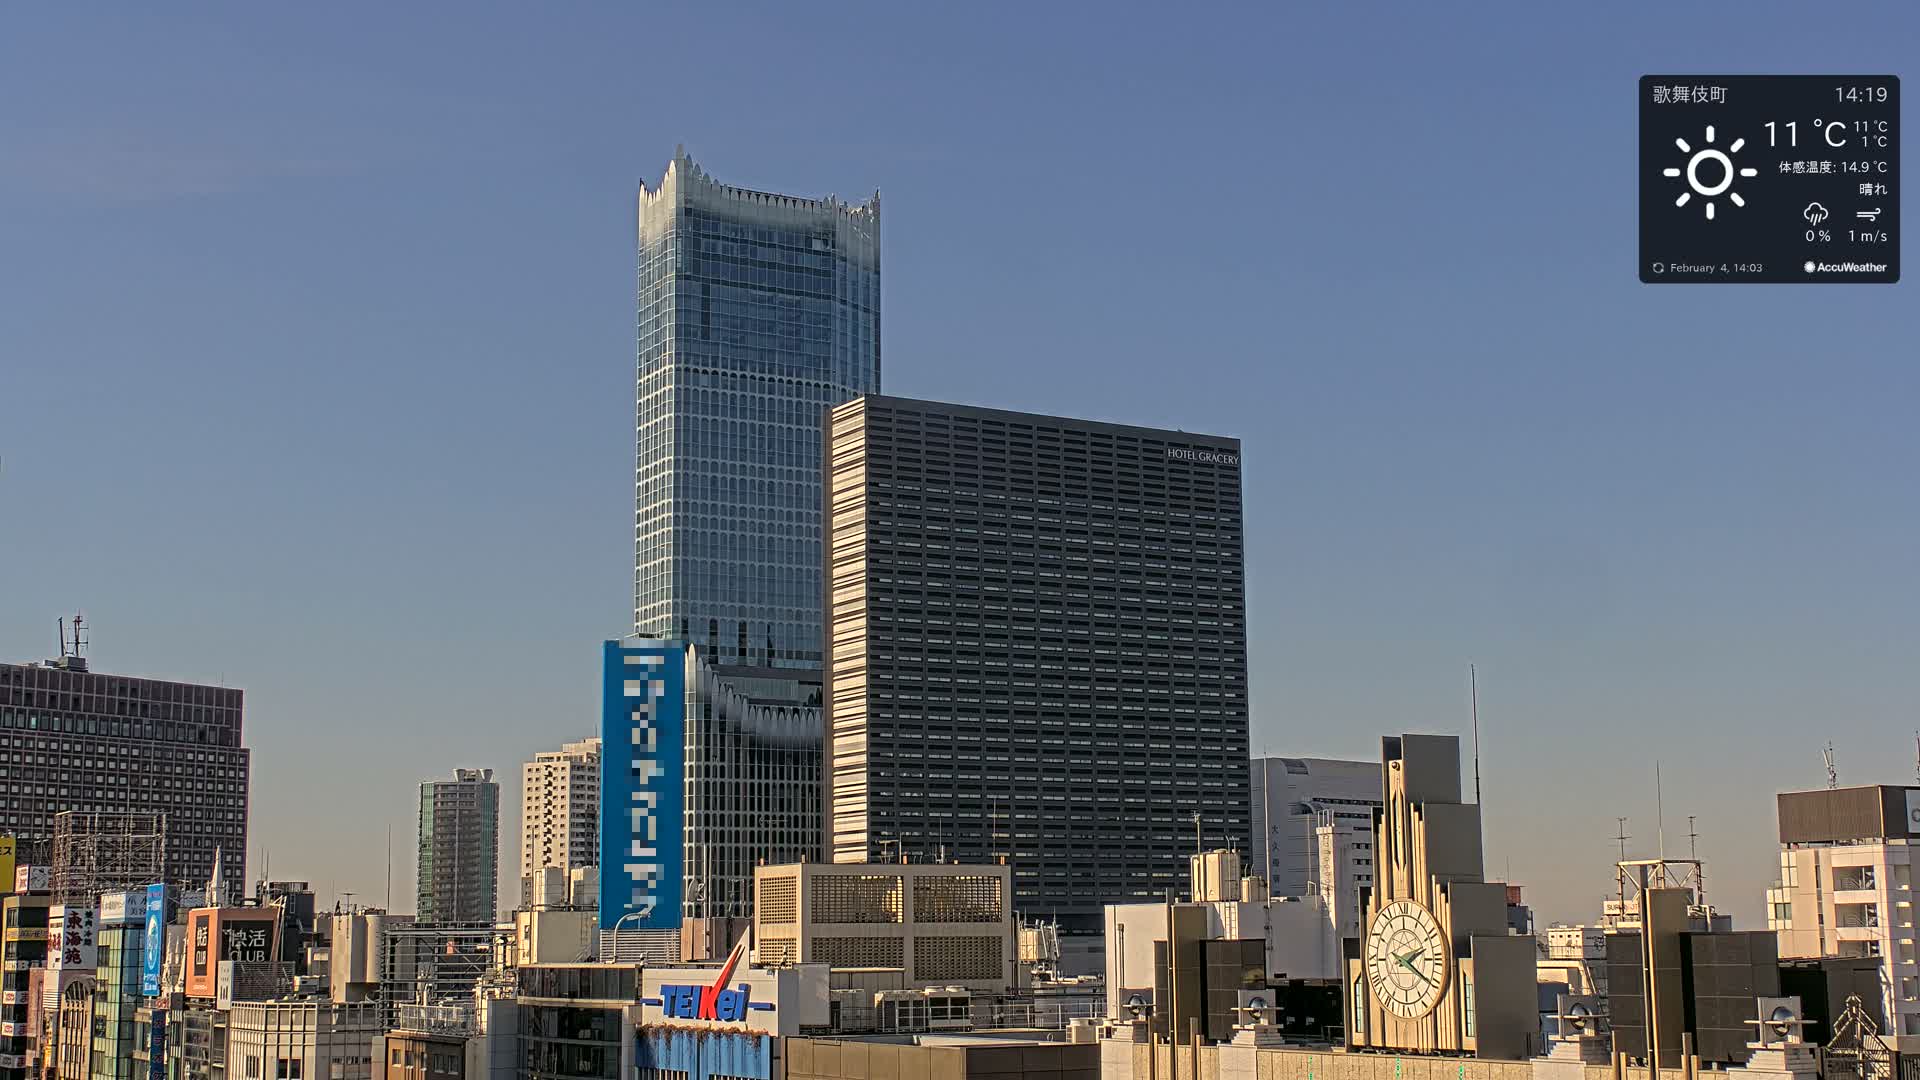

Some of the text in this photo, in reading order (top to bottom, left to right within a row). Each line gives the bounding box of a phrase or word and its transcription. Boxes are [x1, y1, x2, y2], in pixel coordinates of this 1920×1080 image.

[1167, 448, 1239, 465] HOTEL GRACERY
[65, 911, 83, 965] 東海苑
[231, 929, 266, 948] 快活
[231, 950, 266, 962] CLUB
